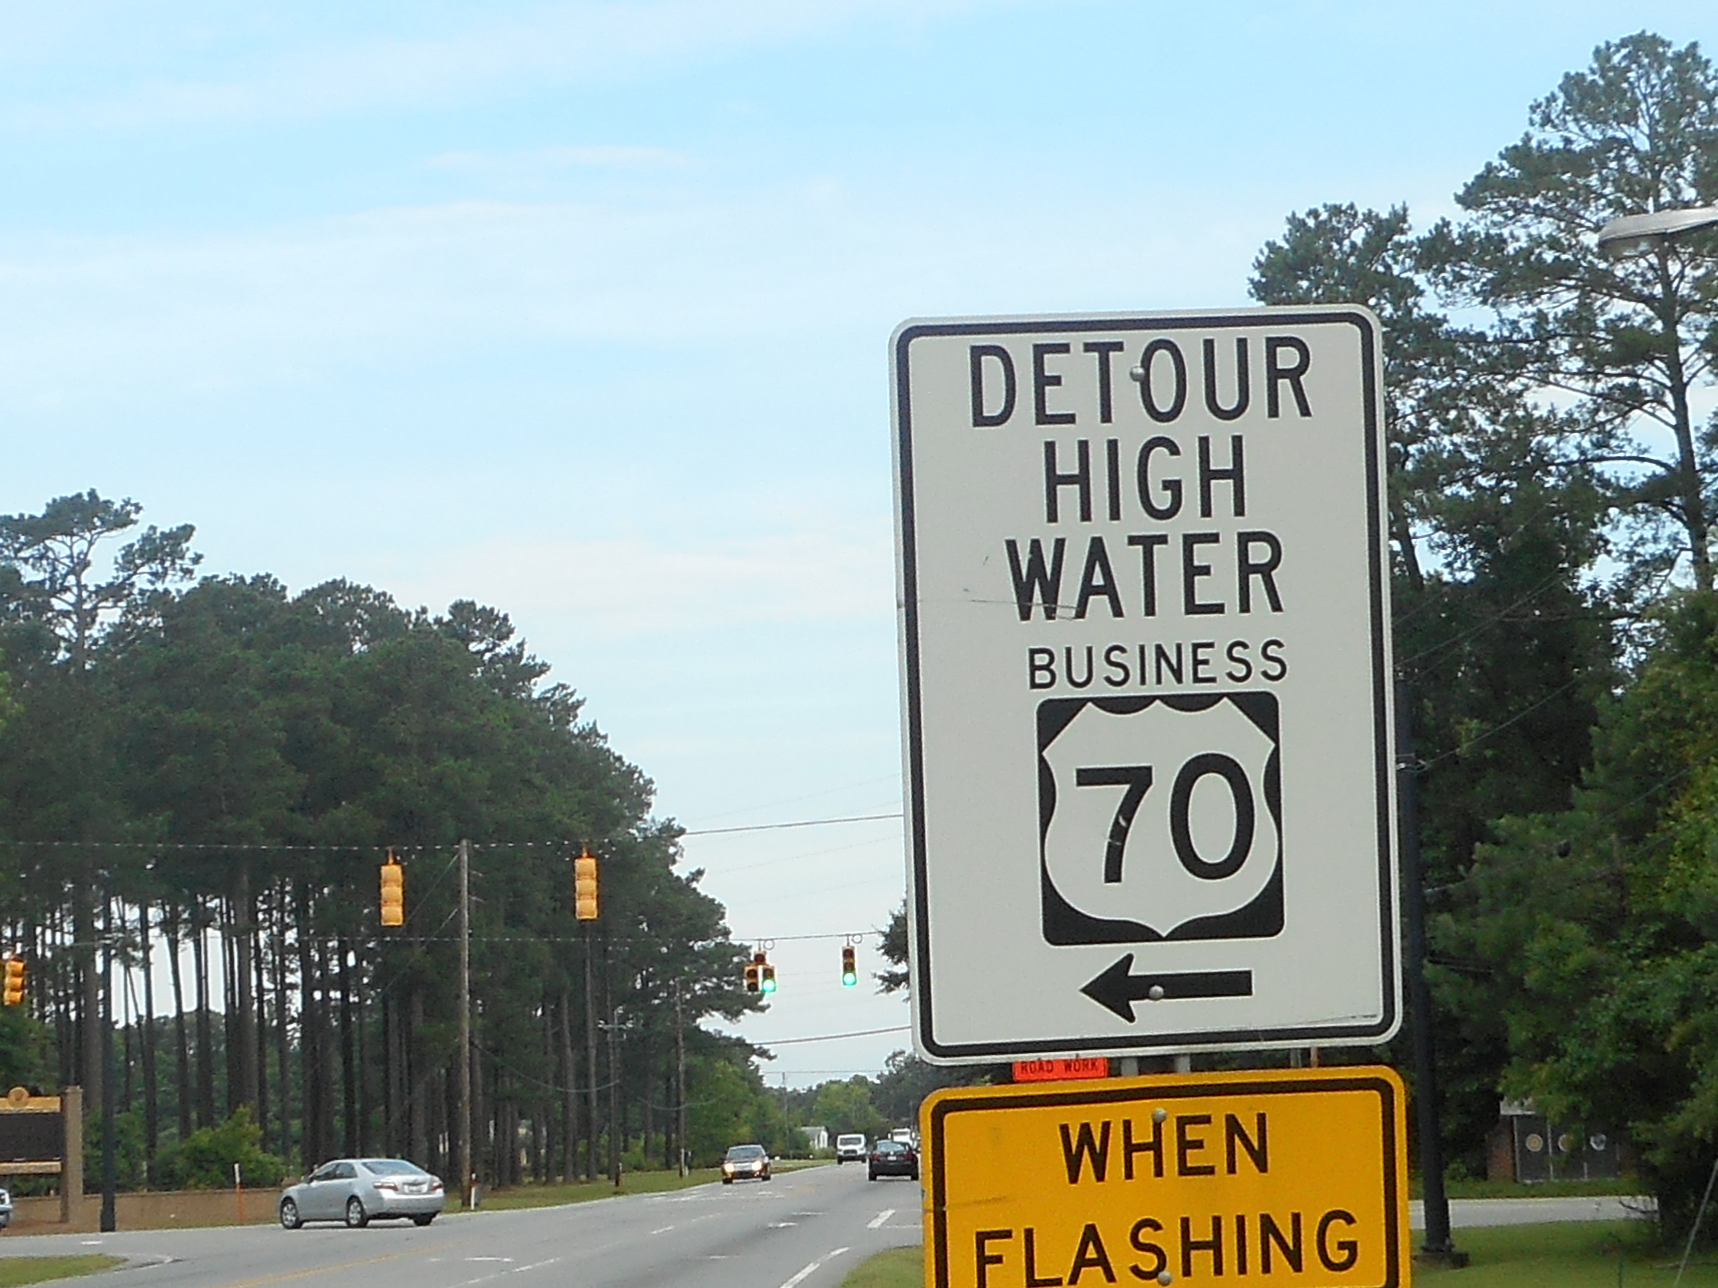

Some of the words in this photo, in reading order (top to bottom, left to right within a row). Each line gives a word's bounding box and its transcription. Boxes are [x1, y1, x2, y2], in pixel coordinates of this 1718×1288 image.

[970, 336, 1312, 427] DETOUR
[1044, 435, 1245, 523] HIGH
[1005, 531, 1283, 621] WATER
[1029, 640, 1286, 689] BUSINESS
[1076, 753, 1254, 883] 70
[1021, 1060, 1054, 1074] ROAD
[1064, 1058, 1098, 1073] WORK
[1059, 1113, 1268, 1184] WHEN
